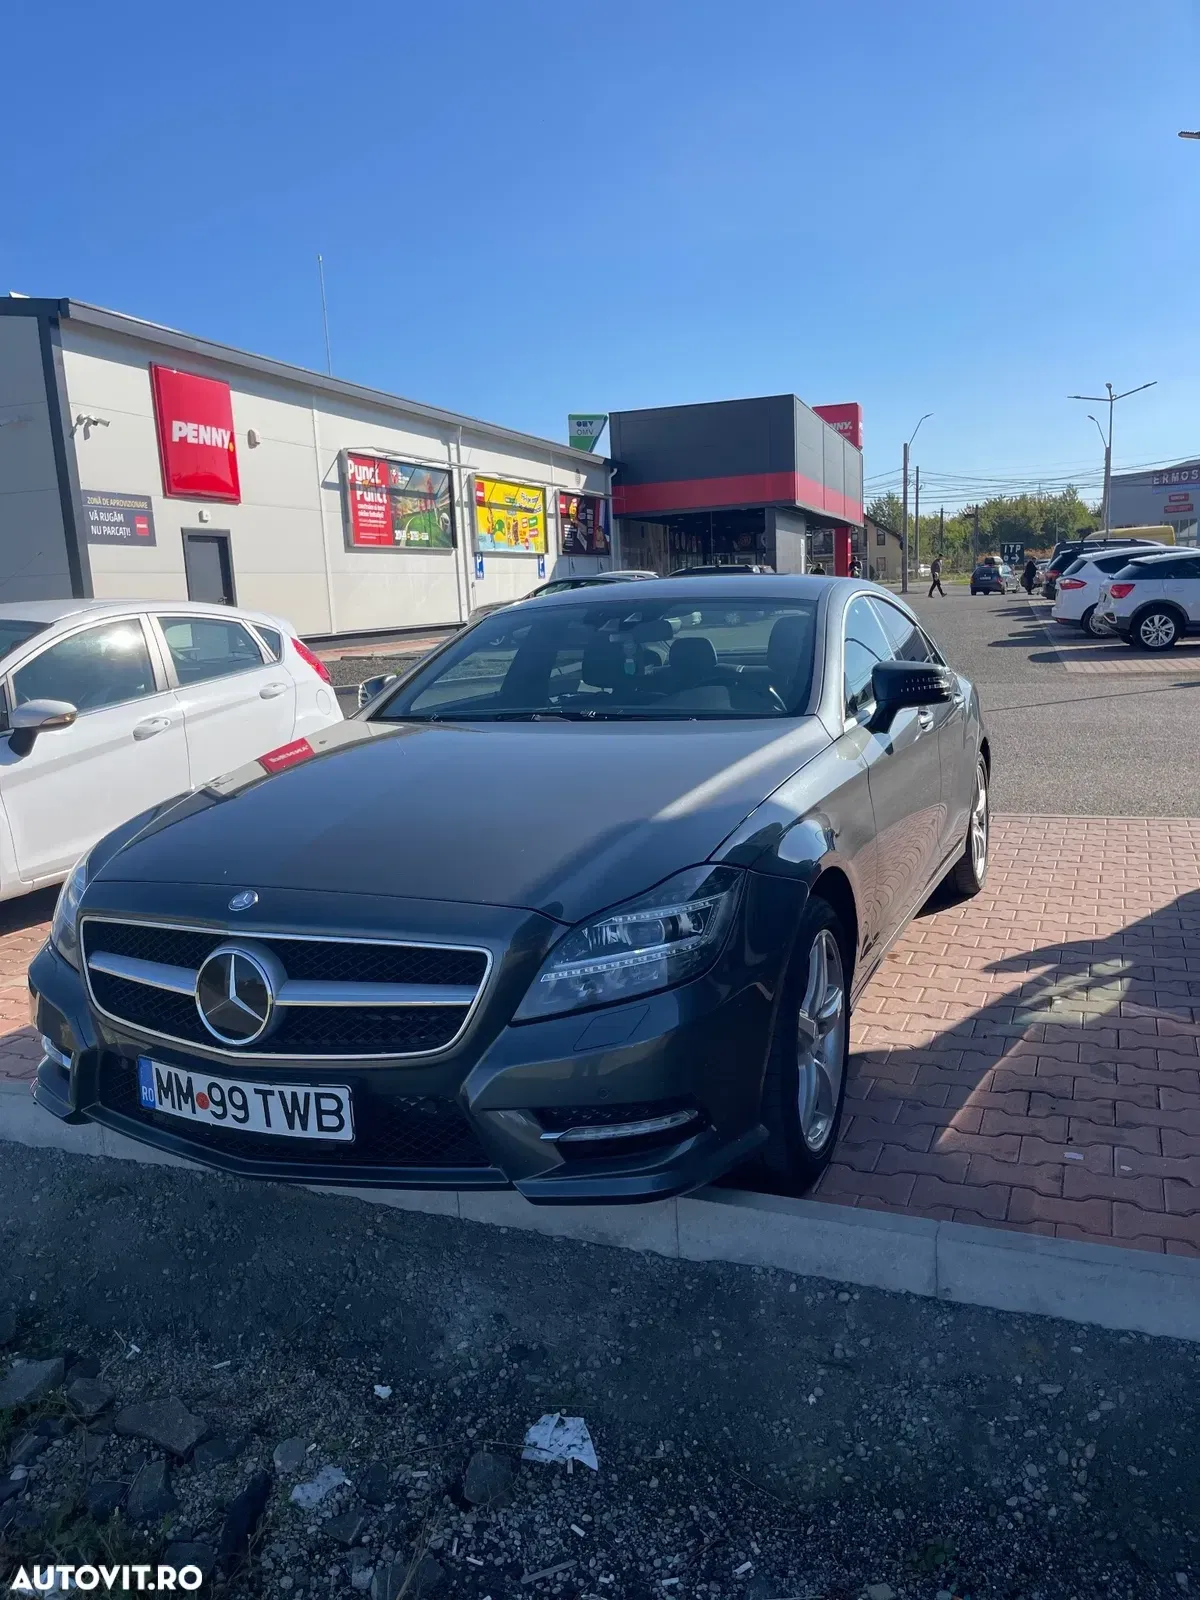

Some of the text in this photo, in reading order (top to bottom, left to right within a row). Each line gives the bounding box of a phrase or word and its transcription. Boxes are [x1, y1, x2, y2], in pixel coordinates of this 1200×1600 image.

[102, 498, 110, 506] DE
[88, 509, 124, 522] VĂ RUGĂM
[91, 525, 102, 535] NU
[1004, 544, 1021, 553] ITP
[141, 1085, 155, 1103] RO
